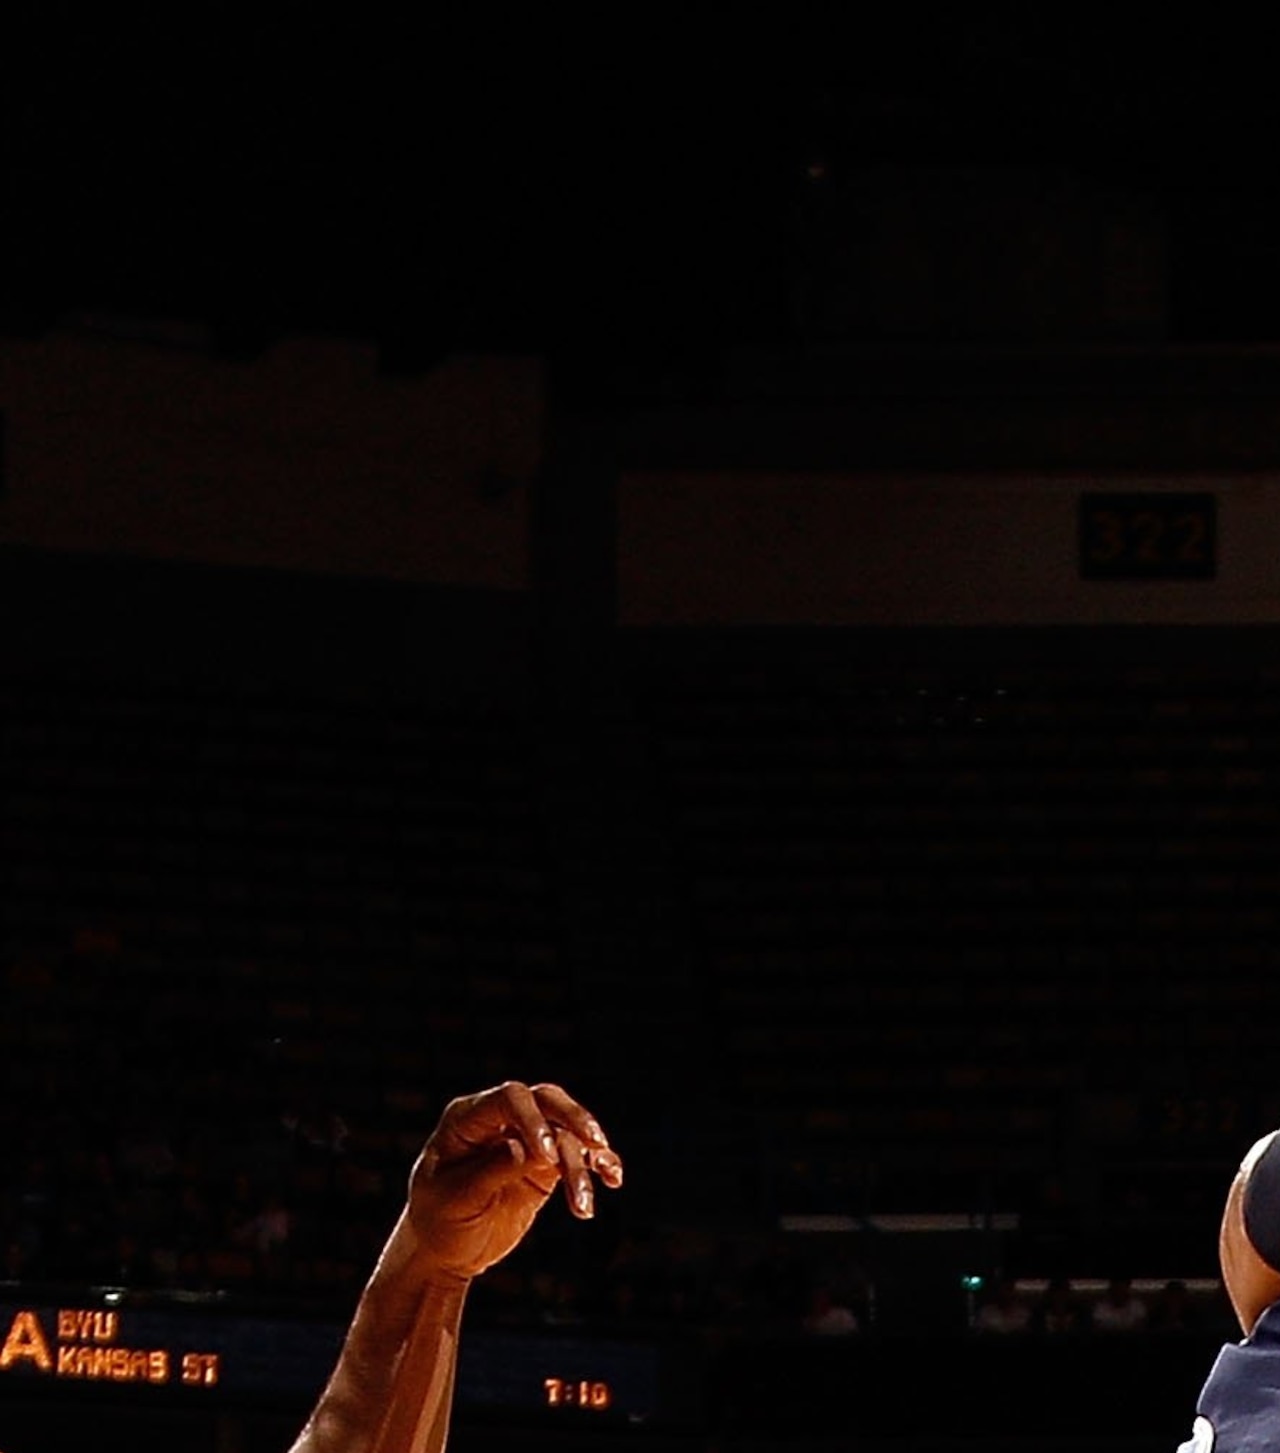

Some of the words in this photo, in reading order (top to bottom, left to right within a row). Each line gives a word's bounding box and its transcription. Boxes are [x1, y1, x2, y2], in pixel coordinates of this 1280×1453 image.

[1090, 510, 1207, 564] 322
[58, 1310, 118, 1341] BYU
[181, 1354, 218, 1384] ST
[544, 1379, 608, 1405] 7:10
